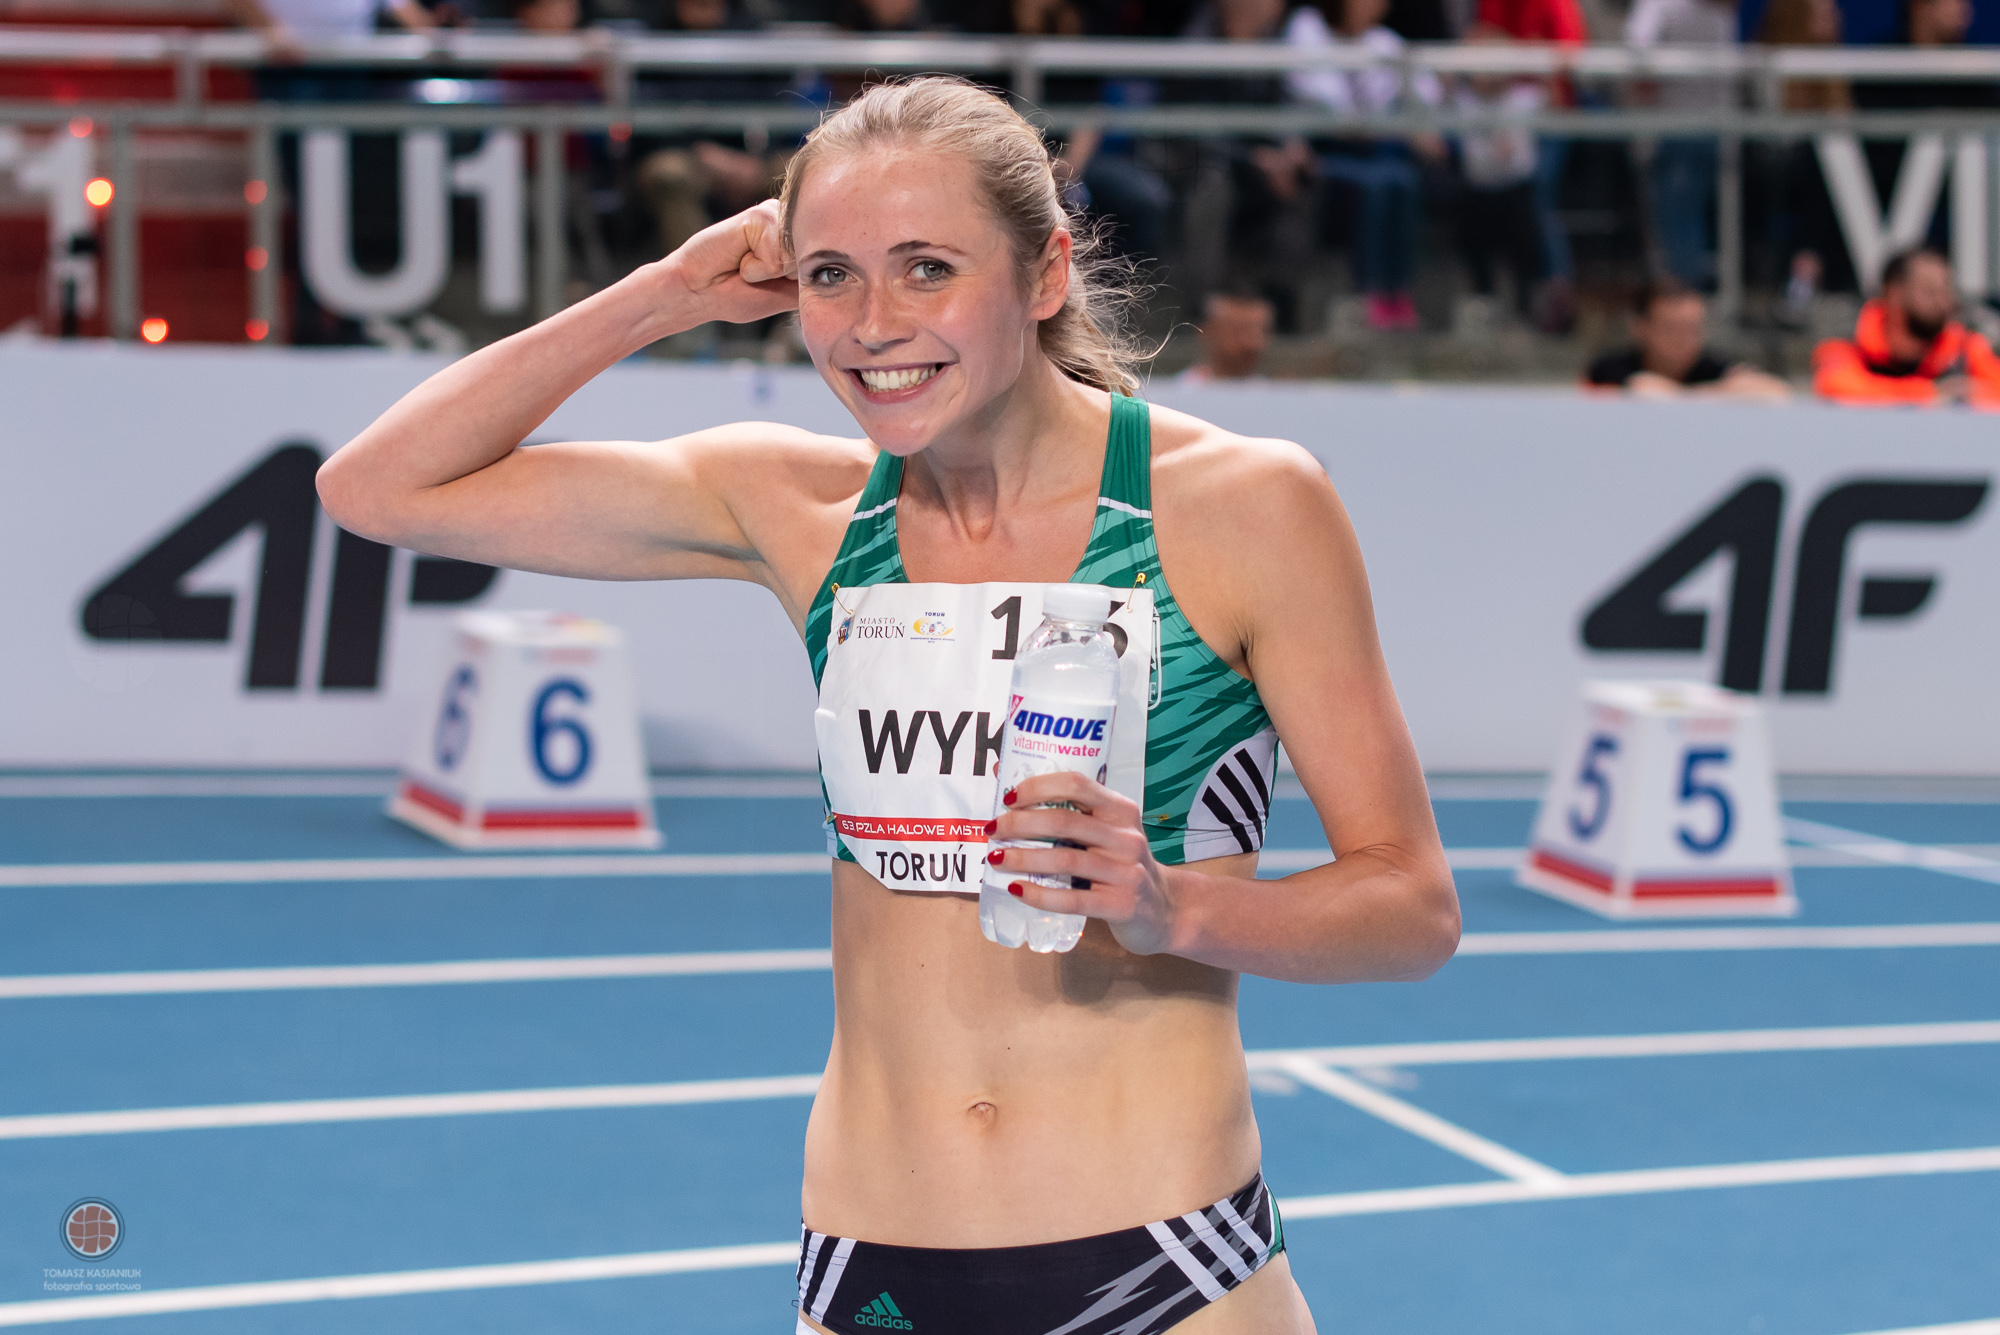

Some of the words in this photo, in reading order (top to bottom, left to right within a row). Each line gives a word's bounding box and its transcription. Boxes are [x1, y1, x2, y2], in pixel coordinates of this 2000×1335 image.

[301, 130, 526, 315] U1
[1581, 477, 1990, 694] 4F
[856, 622, 906, 639] TORUŃ
[859, 617, 896, 625] MIASTO
[529, 675, 592, 787] 6
[1013, 709, 1108, 741] 4MOVE
[1013, 734, 1101, 757] vitaminwater
[1566, 732, 1620, 841] 5
[1674, 747, 1735, 857] 5
[855, 822, 886, 835] PZLA
[887, 823, 945, 836] HALOWE
[876, 844, 967, 883] TORUŃ
[854, 1312, 913, 1331] adidas
